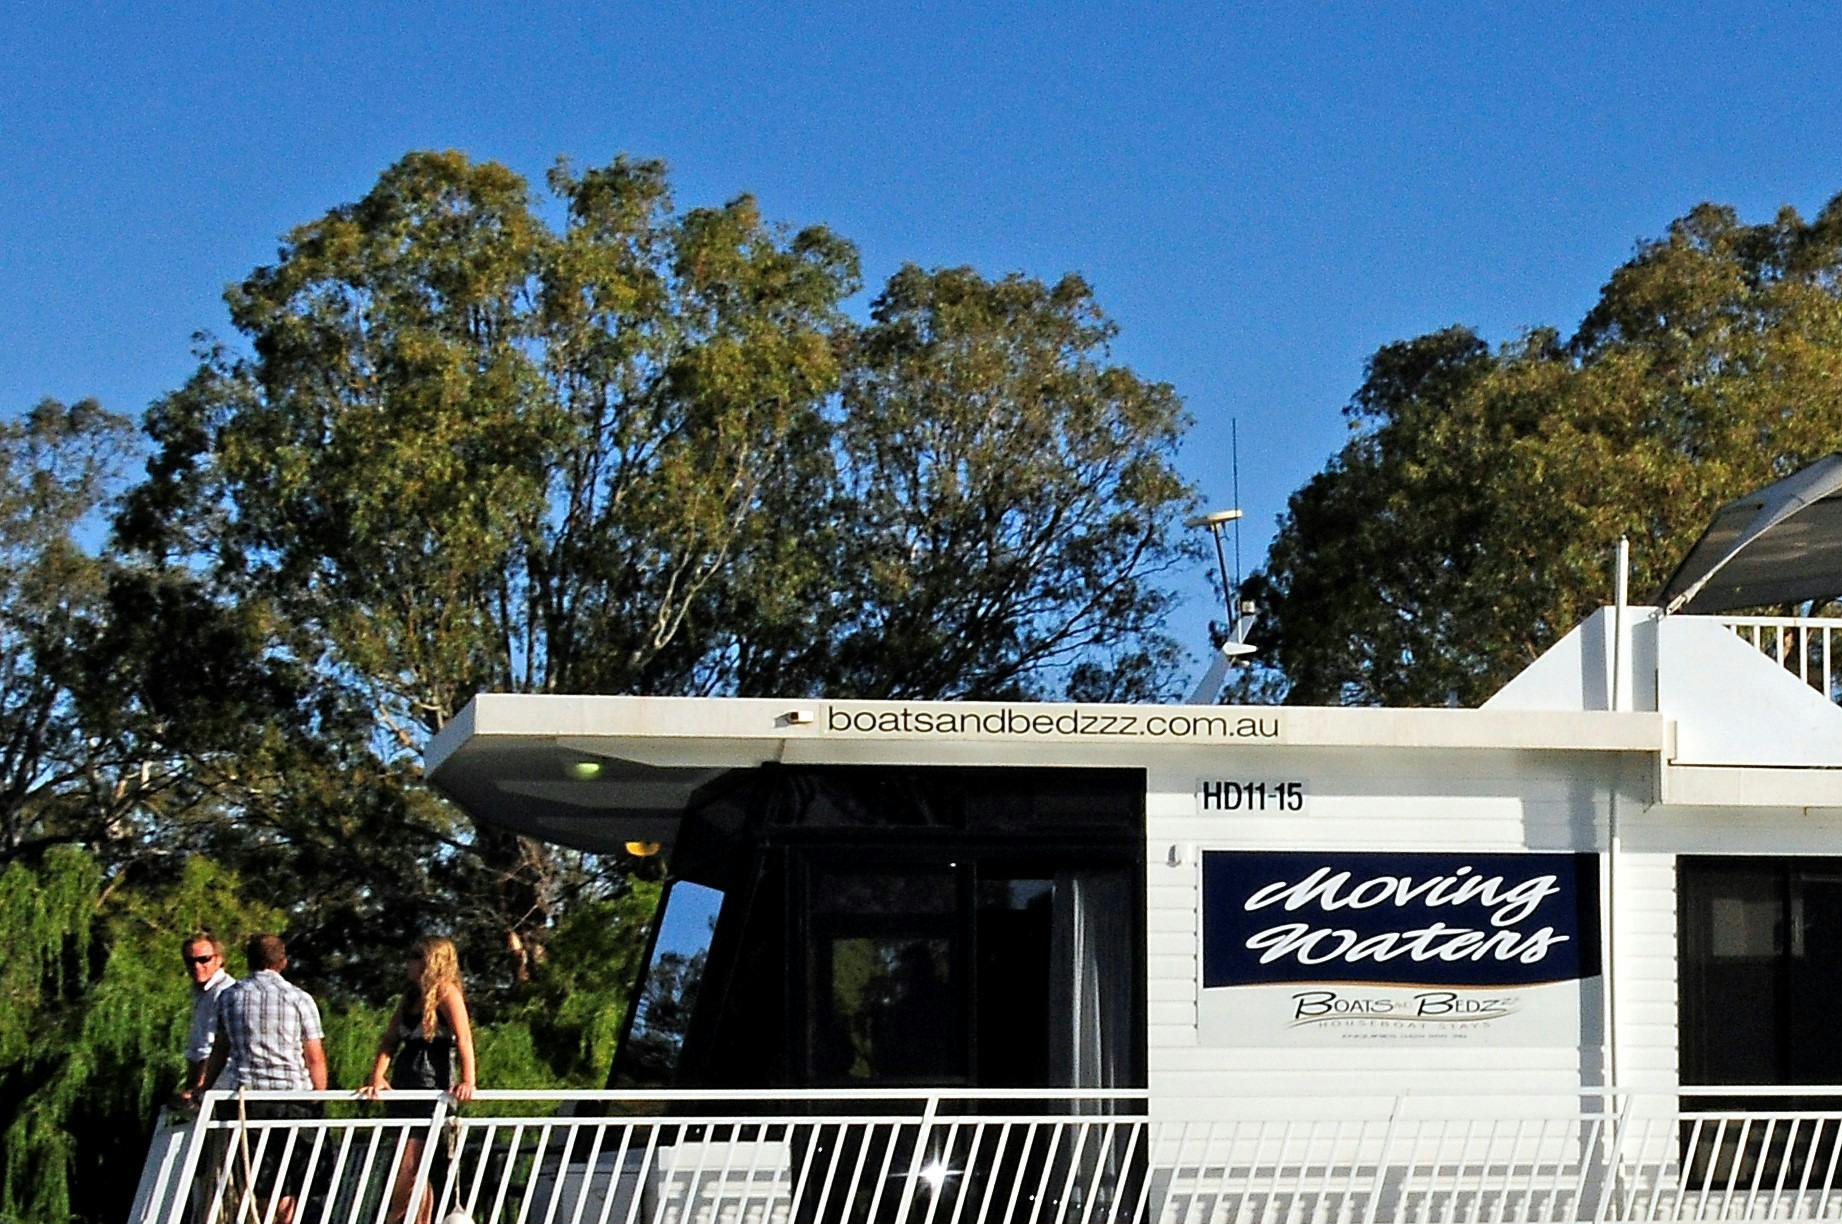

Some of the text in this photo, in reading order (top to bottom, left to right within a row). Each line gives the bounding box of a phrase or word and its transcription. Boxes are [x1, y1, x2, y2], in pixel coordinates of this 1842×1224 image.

[827, 705, 1280, 738] boatsandbedzzz.com.au
[1203, 782, 1303, 812] HD11-15
[1244, 866, 1560, 927] Moving
[1245, 922, 1570, 965] Waters
